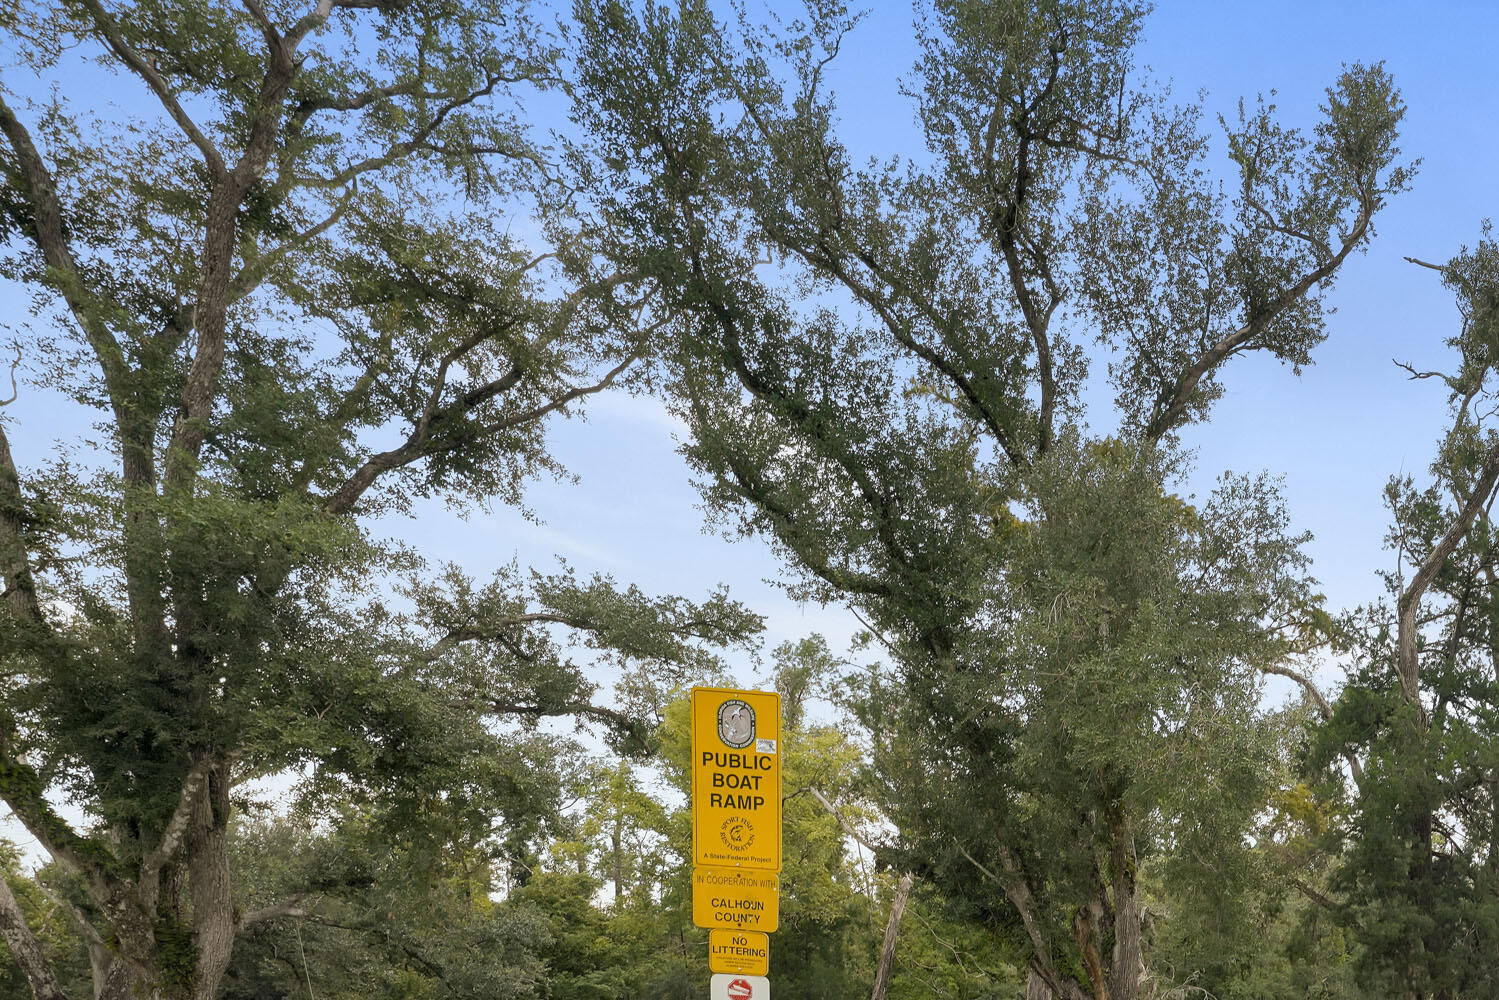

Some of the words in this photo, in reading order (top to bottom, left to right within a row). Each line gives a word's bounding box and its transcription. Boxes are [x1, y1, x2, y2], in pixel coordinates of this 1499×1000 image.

[702, 751, 772, 771] PUBLIC
[712, 773, 763, 790] BOAT
[710, 793, 765, 811] RAMP
[720, 816, 739, 831] SPORT
[741, 817, 754, 831] FISH
[720, 832, 755, 852] RESTORATION
[750, 855, 772, 864] Project
[697, 874, 704, 884] IN
[706, 875, 758, 888] COOPERATION
[760, 879, 776, 889] WITH
[711, 898, 764, 911] CALHOUN
[714, 912, 761, 925] COUNTY
[732, 937, 748, 946] NO
[712, 945, 766, 958] LITTERING
